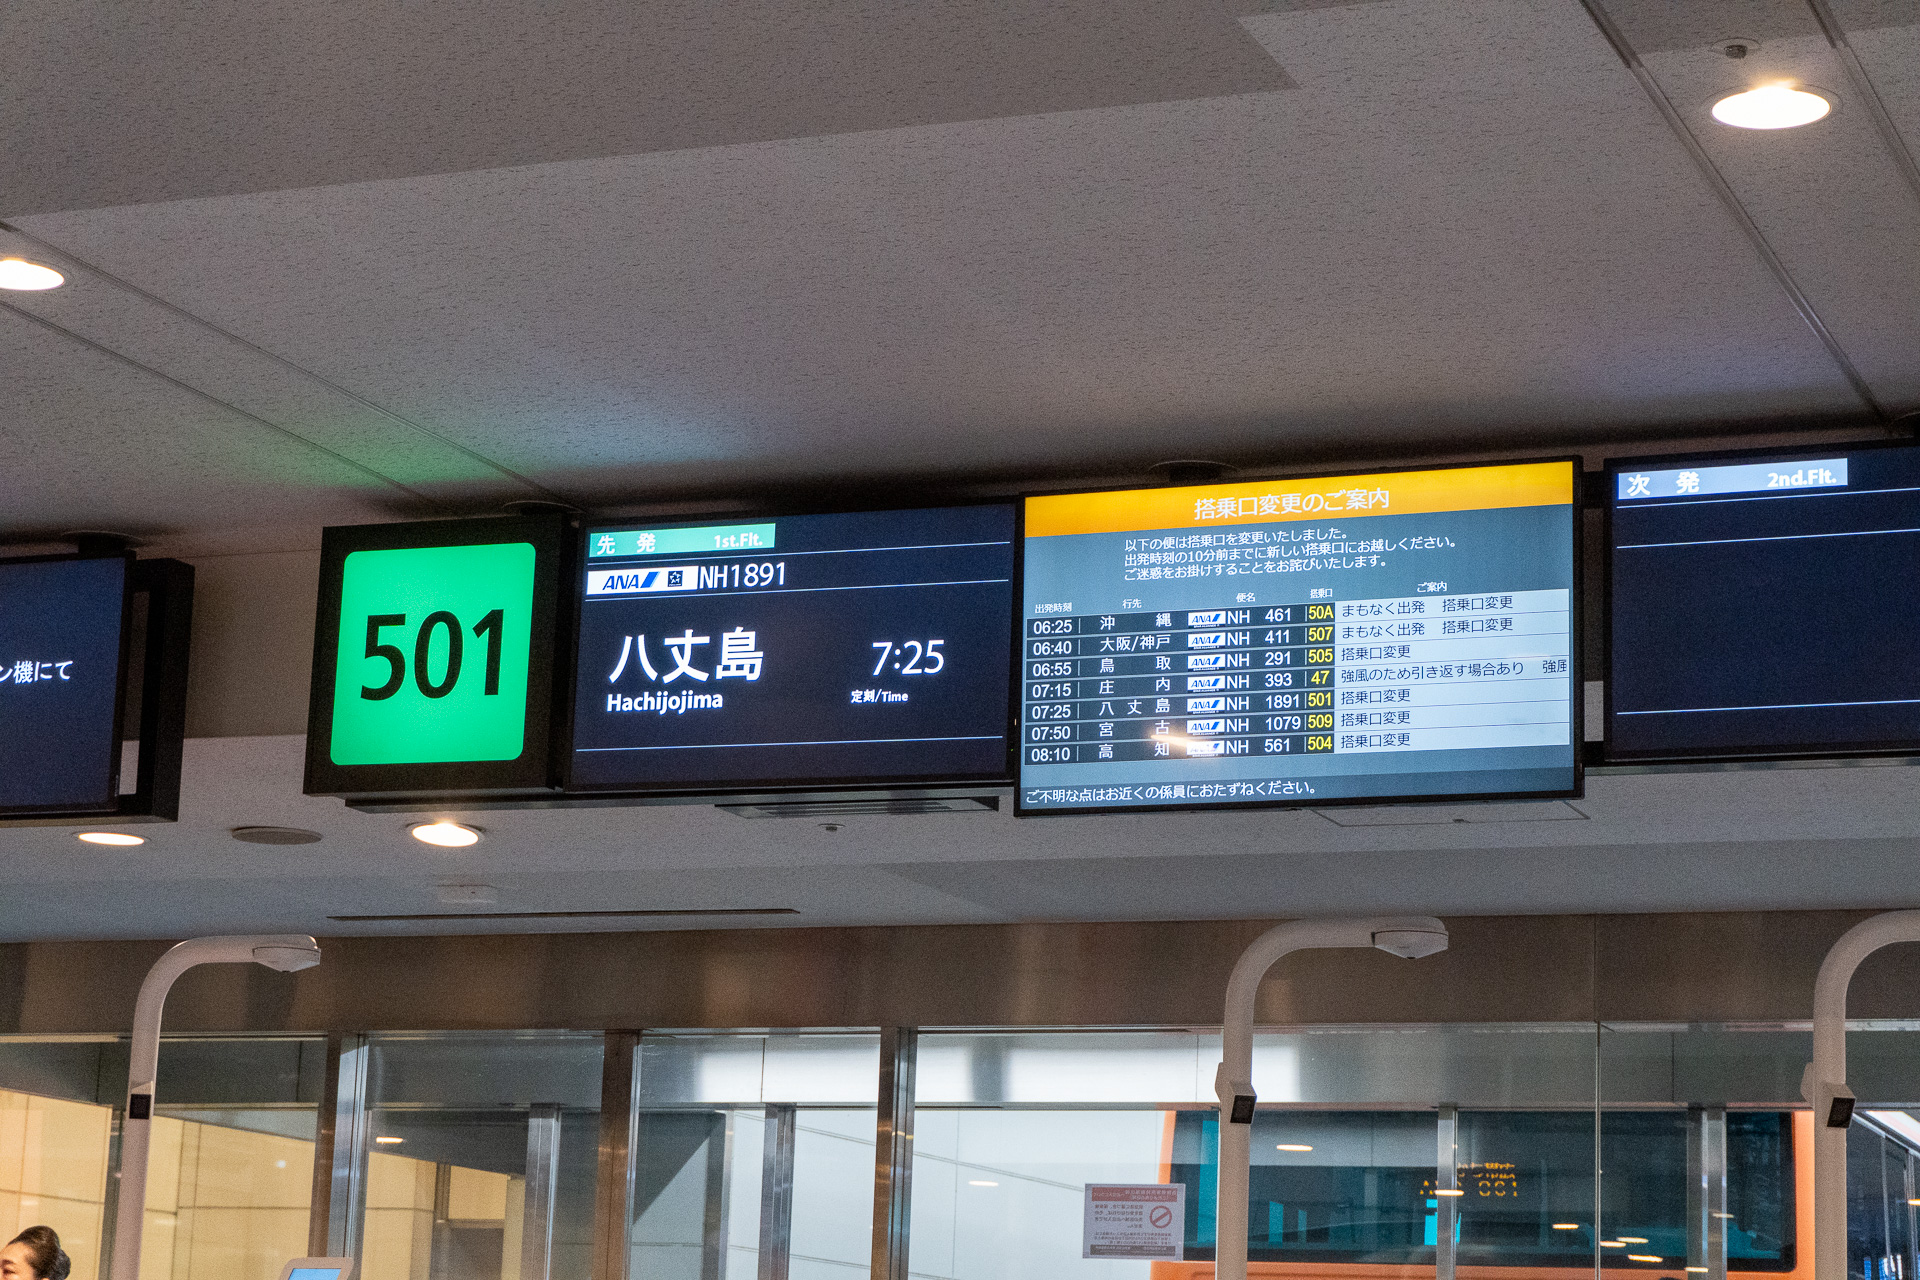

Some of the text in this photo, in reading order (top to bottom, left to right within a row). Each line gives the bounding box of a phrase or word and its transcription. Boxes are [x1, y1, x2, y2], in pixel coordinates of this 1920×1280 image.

[1767, 468, 1837, 487] 2nd.Flt.
[1195, 488, 1390, 520] 搭乗口変更のご案内
[714, 532, 763, 548] 1st.Flt.
[1124, 534, 1456, 567] 出発時刻の10分前までに新しい搭乗口にお越しください。
[1125, 528, 1348, 552] 以下の便は搭乗口を変更いたしました。
[603, 562, 785, 590] ANA NH1891
[1124, 555, 1386, 581] ご迷惑をお掛けすることをお詫びいたします。
[1035, 582, 1447, 613] 出発時刻 行先 便名 搭乗口 ご案内
[1033, 619, 1072, 634] 06:25
[1228, 610, 1250, 624] NH
[1265, 608, 1291, 622] 461
[1309, 605, 1334, 619] 50A
[1342, 601, 1425, 617] まもなく出発
[1442, 596, 1513, 612] 搭乗口変更
[1033, 618, 1513, 655] 06:40 大阪/神戸 ANA NH 411 507 まもなく出発 搭乗口変更
[360, 608, 505, 701] 501
[610, 626, 945, 684] 八丈島 7:25
[1033, 662, 1072, 677] 06:55
[1227, 654, 1249, 667] NH
[1265, 652, 1291, 665] 291
[1308, 649, 1333, 663] 505
[1342, 645, 1410, 661] 搭乗口変更
[1033, 683, 1071, 698] 07:15
[1191, 680, 1211, 688] ANA
[1227, 675, 1249, 689] NH
[1265, 673, 1292, 687] 393
[1311, 672, 1329, 684] 47
[1342, 662, 1524, 683] 強風のため引き返す場合あり
[607, 688, 908, 715] Hachijojima 定刻/Time
[1032, 705, 1071, 719] 07:25
[1191, 702, 1211, 710] ANA
[1227, 697, 1249, 711] NH
[1266, 695, 1300, 709] 1891
[1308, 693, 1333, 706] 501
[1341, 689, 1410, 705] 搭乗口変更
[1032, 726, 1071, 741] 07:50
[1227, 718, 1249, 732] NH
[1266, 717, 1301, 730] 1079
[1308, 714, 1332, 728] 509
[1341, 711, 1410, 727] 搭乗口変更
[1032, 747, 1070, 762] 08:10
[1226, 740, 1249, 754] NH
[1265, 739, 1290, 752] 561
[1308, 736, 1332, 750] 504
[1341, 733, 1410, 748] 搭乗口変更
[1026, 781, 1315, 804] ご不明な点はお近くの係員におたずねください。
